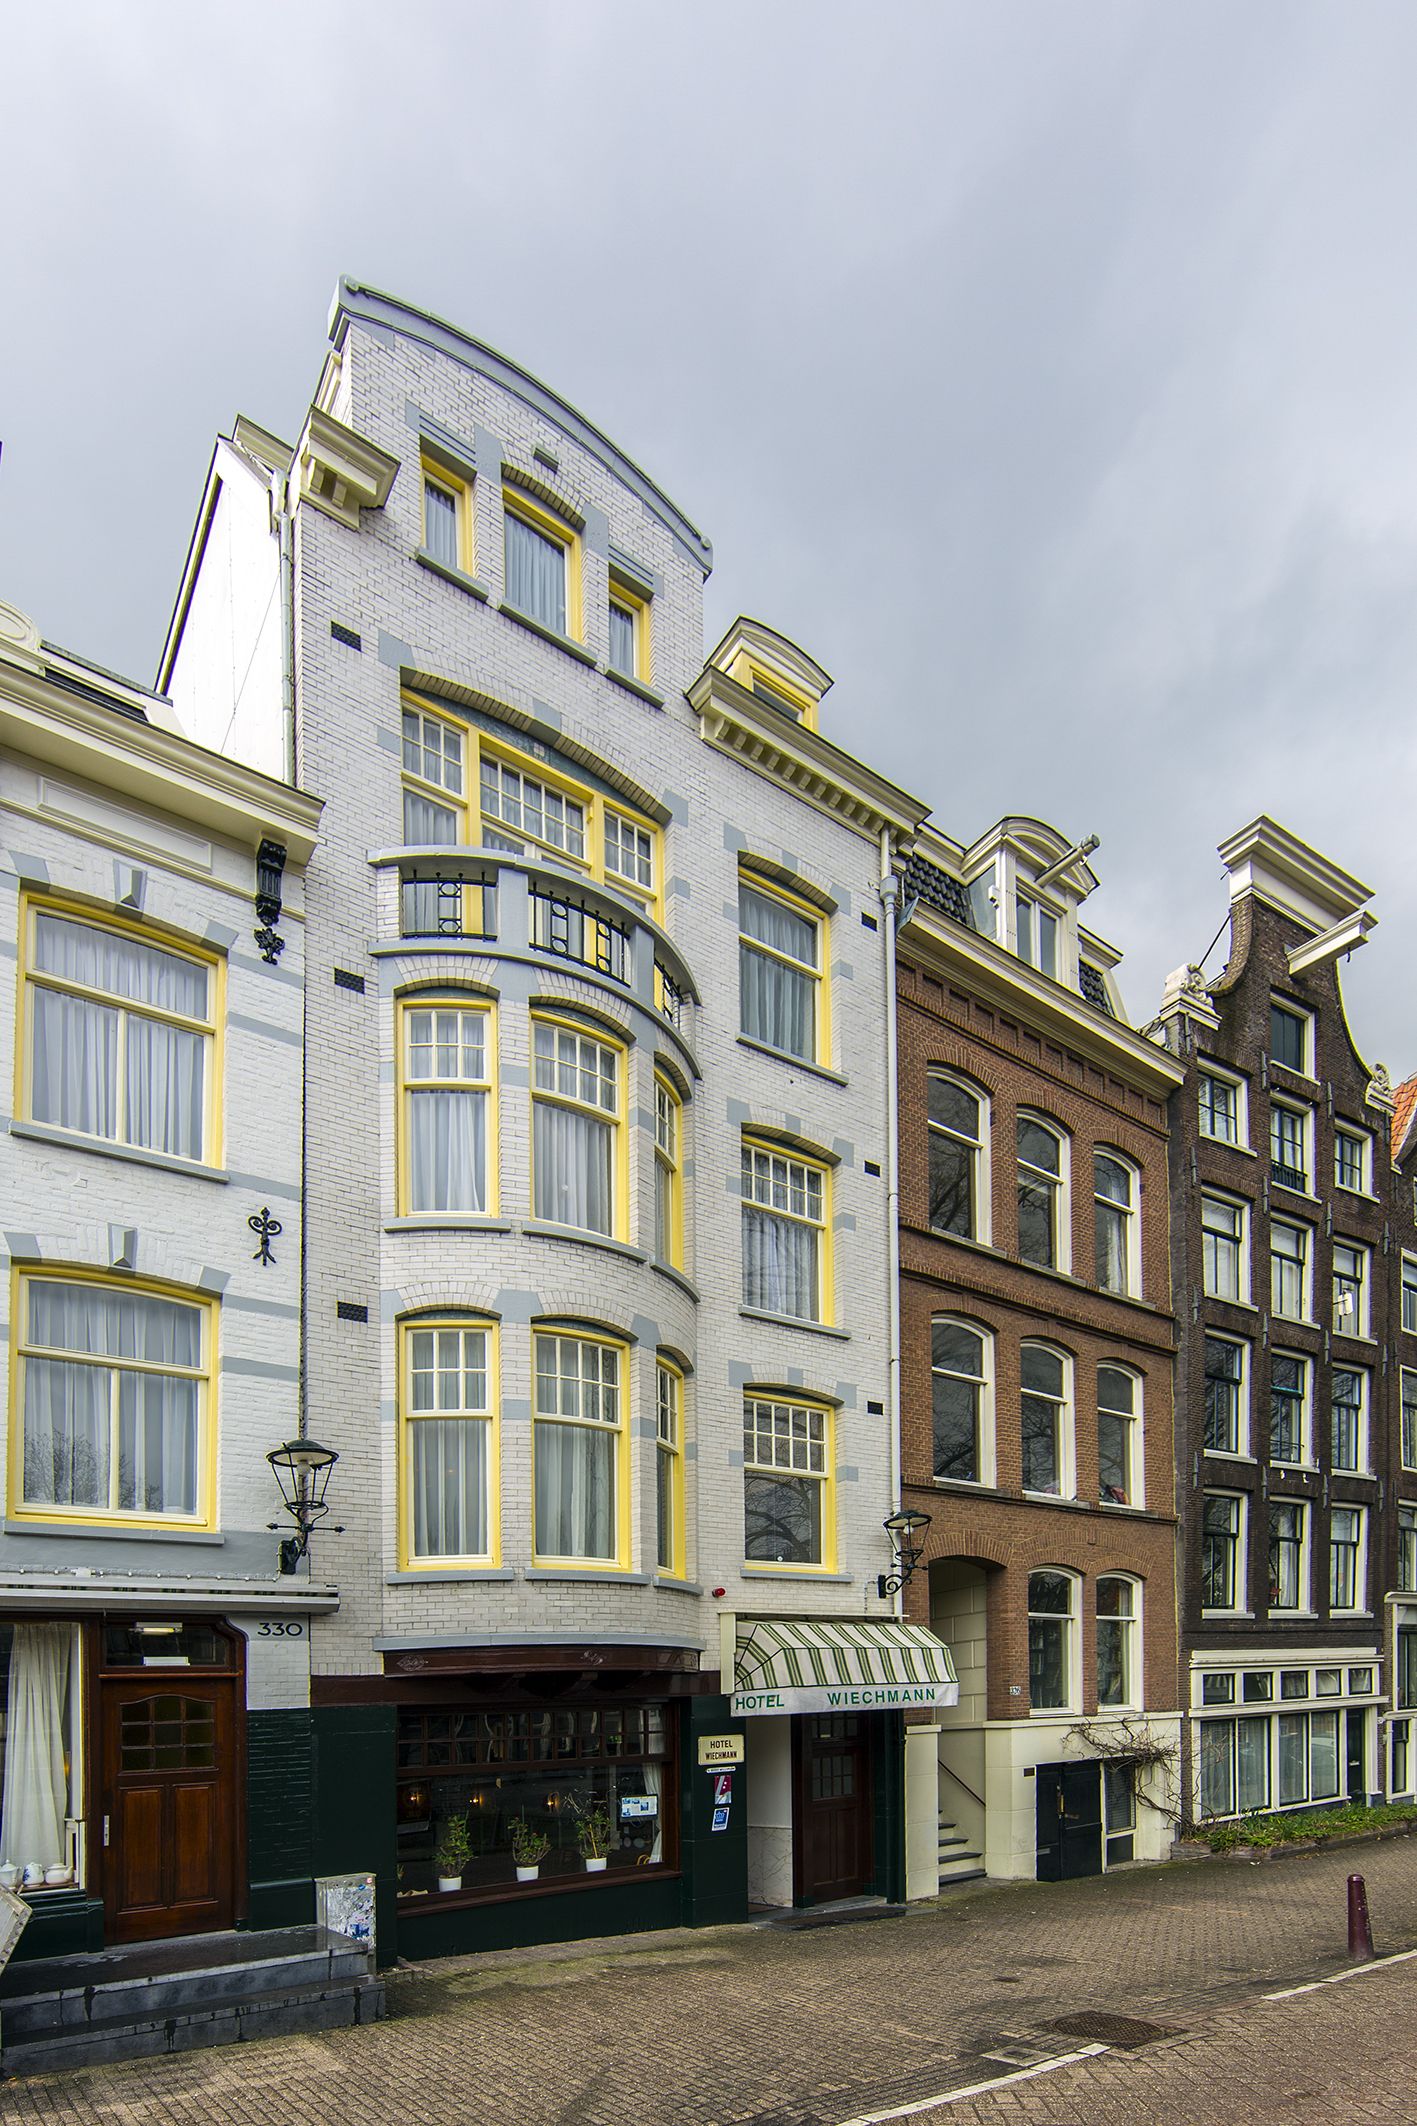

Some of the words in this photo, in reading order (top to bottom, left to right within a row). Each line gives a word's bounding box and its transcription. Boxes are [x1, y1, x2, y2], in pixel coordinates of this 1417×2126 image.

[257, 1622, 303, 1637] 330
[735, 1694, 785, 1710] HOTEL
[827, 1688, 936, 1706] WIECHMANN
[710, 1740, 733, 1749] HOTEL
[705, 1751, 737, 1760] WIECHMANN
